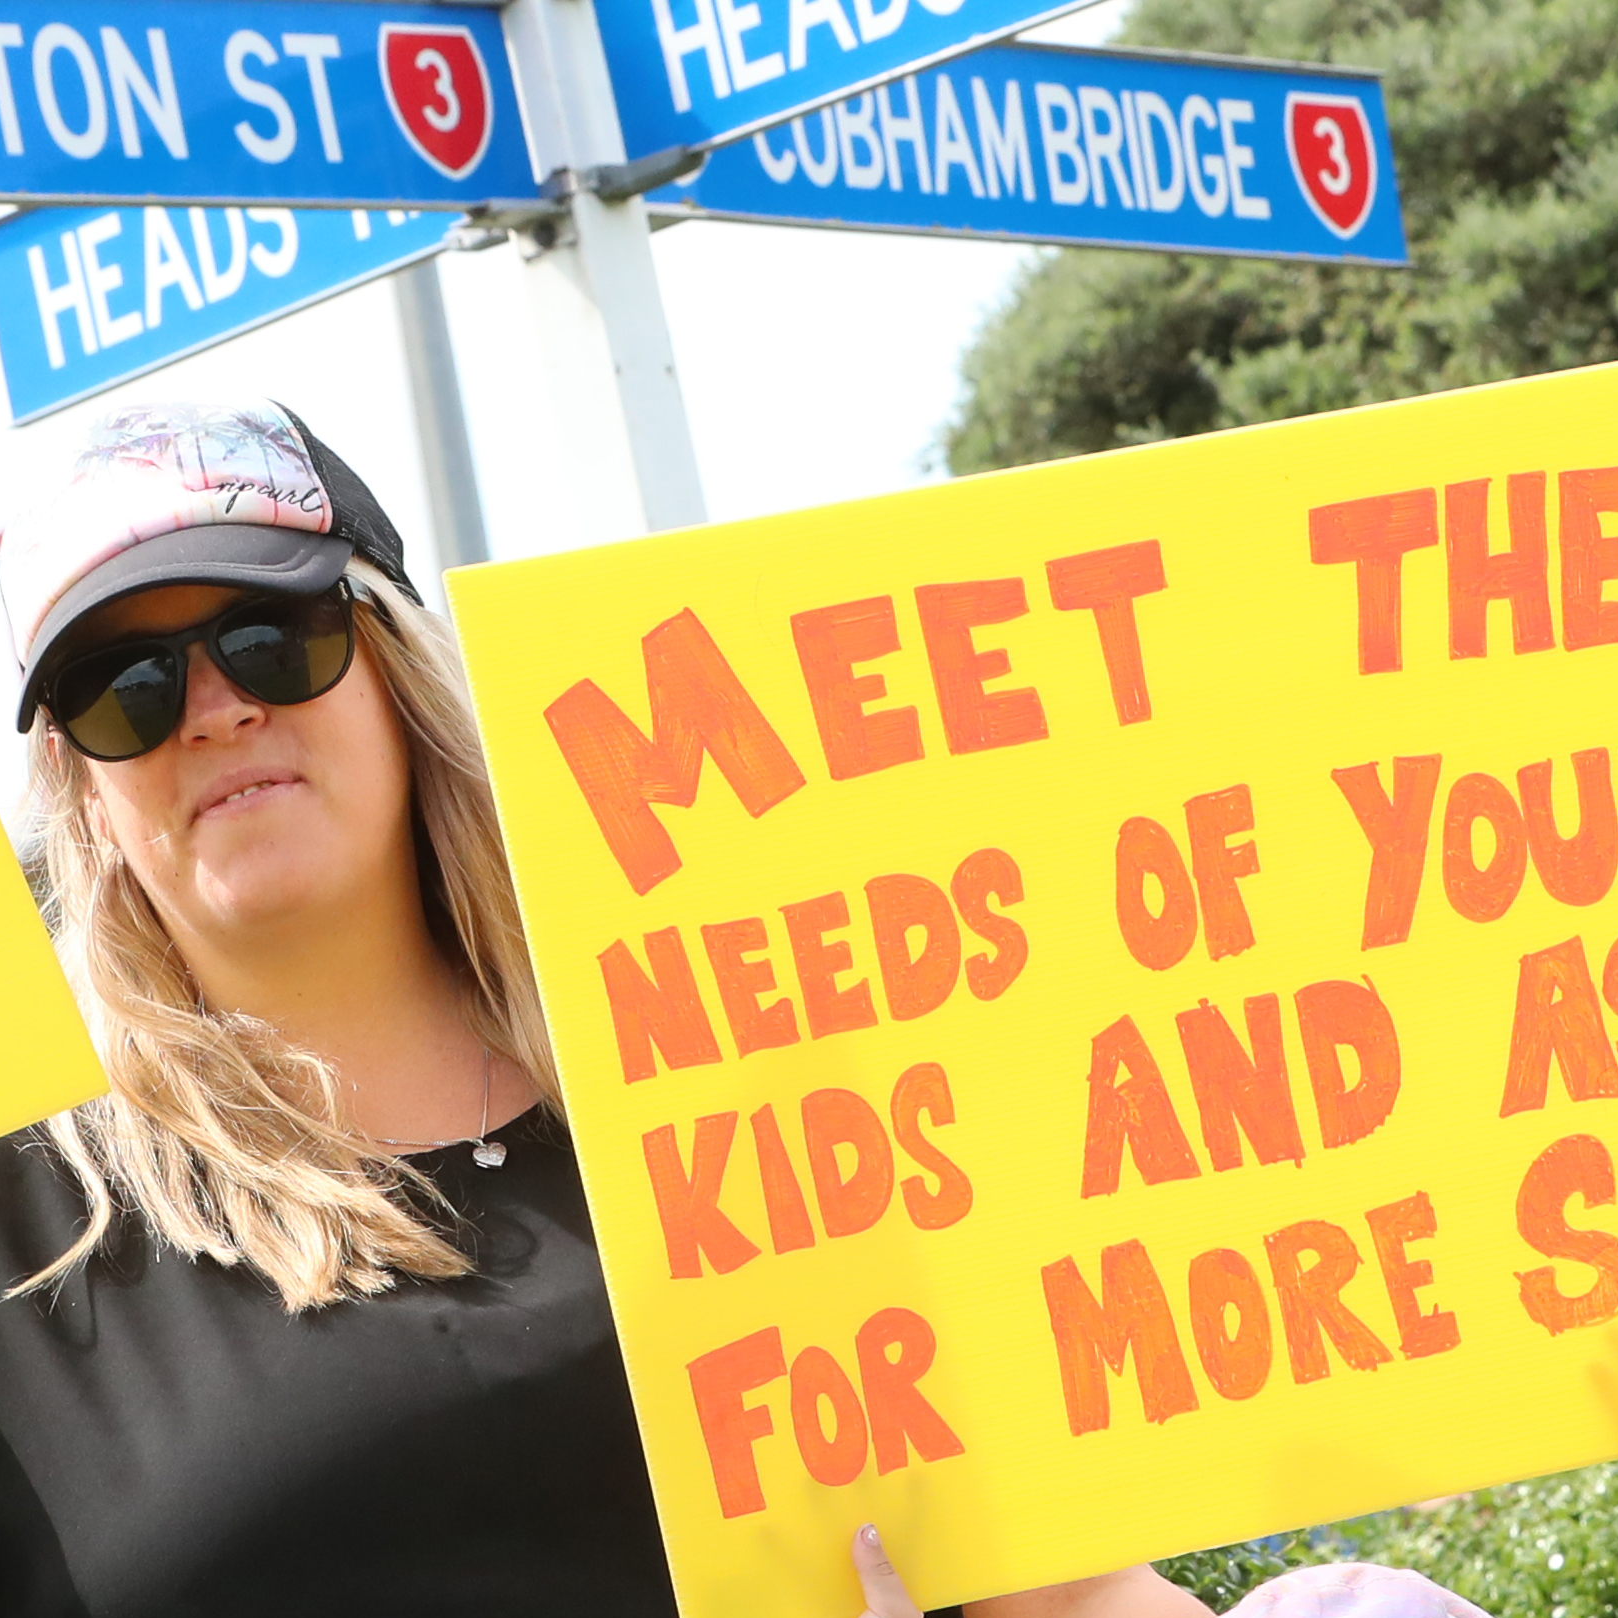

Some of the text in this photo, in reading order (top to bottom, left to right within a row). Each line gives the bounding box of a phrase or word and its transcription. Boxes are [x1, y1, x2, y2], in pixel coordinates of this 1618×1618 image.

[223, 29, 343, 163] ST
[413, 47, 460, 132] 3
[650, 0, 965, 112] HEA
[1034, 83, 1272, 220] BRIDGE
[1312, 116, 1352, 196] 3
[544, 541, 1165, 895] MEET
[598, 849, 1027, 1083] NEEDS
[1115, 785, 1257, 970] OF
[643, 1063, 971, 1278] KIDS
[1081, 975, 1400, 1199] AND
[688, 1308, 963, 1518] FOR
[1043, 1192, 1459, 1435] MORE
